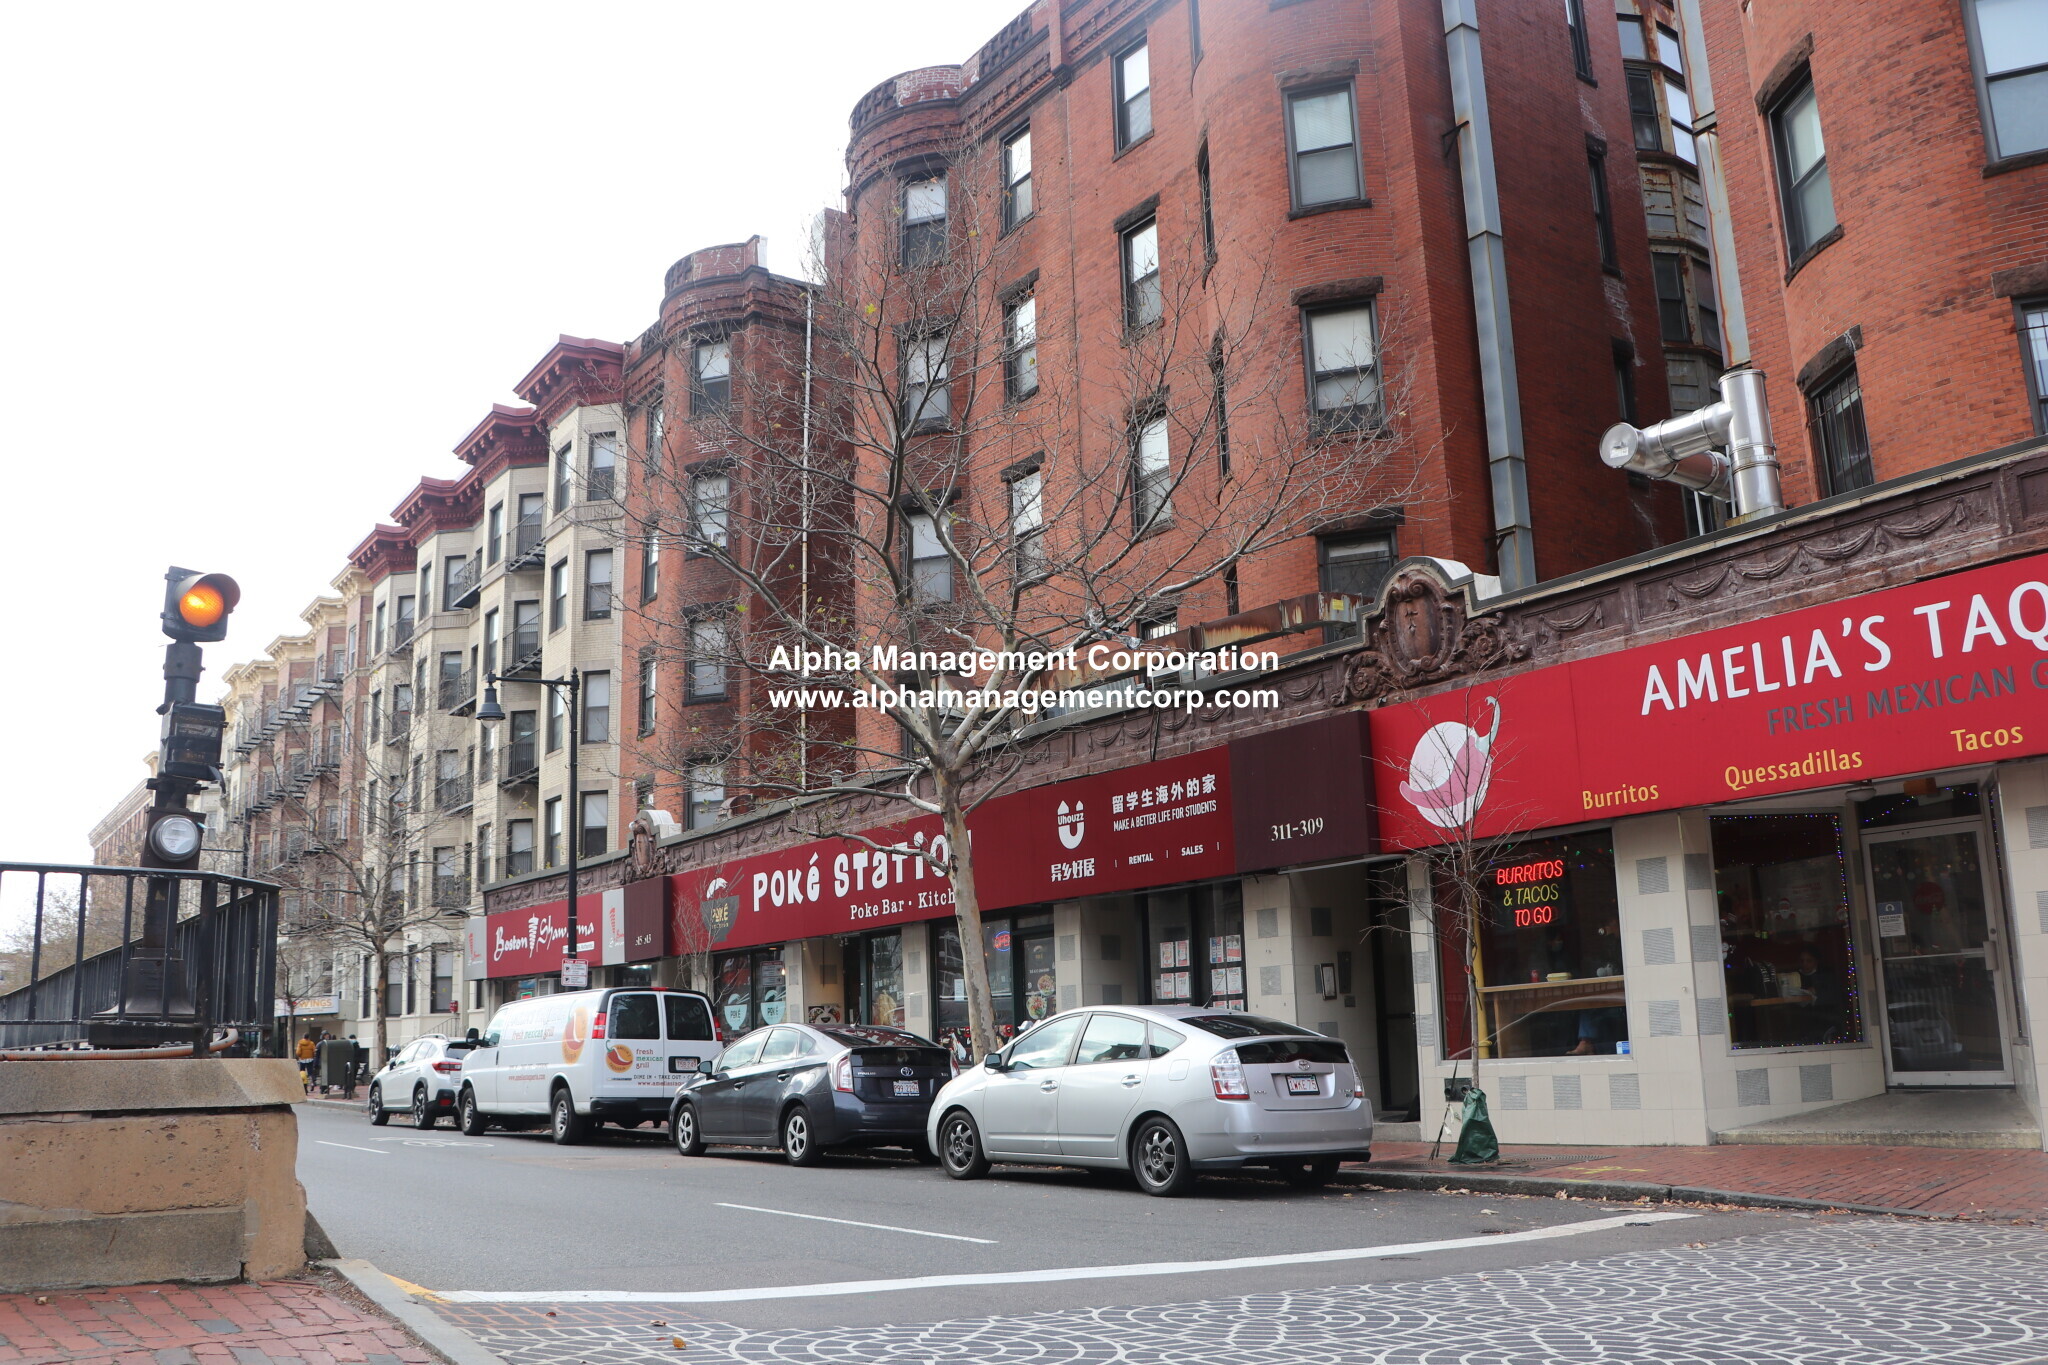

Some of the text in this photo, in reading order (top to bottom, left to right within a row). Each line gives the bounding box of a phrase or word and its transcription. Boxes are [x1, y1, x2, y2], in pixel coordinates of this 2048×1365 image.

[1913, 581, 2048, 659] TAQ
[1767, 695, 1854, 736] FRESH
[1867, 665, 2016, 719] MEXICAN
[1950, 726, 2024, 752] Tacos
[1724, 749, 1863, 791] Quessadillas
[1112, 773, 1216, 814] 留学生海外的家
[1582, 784, 1659, 809] Burritos
[1057, 812, 1084, 826] Uhouzz
[1113, 799, 1217, 832] MAKE A BETTER LIFE FOR STUDENTS
[1271, 816, 1324, 842] 311-309
[1128, 844, 1204, 865] RENTAL SALES
[1497, 860, 1564, 885] BURRITOS
[850, 887, 956, 920] Poke Bar Kitch
[1503, 883, 1559, 907] & TACOS
[1515, 906, 1552, 927] TO GO
[494, 926, 528, 961] Boston
[636, 1061, 650, 1069] grill
